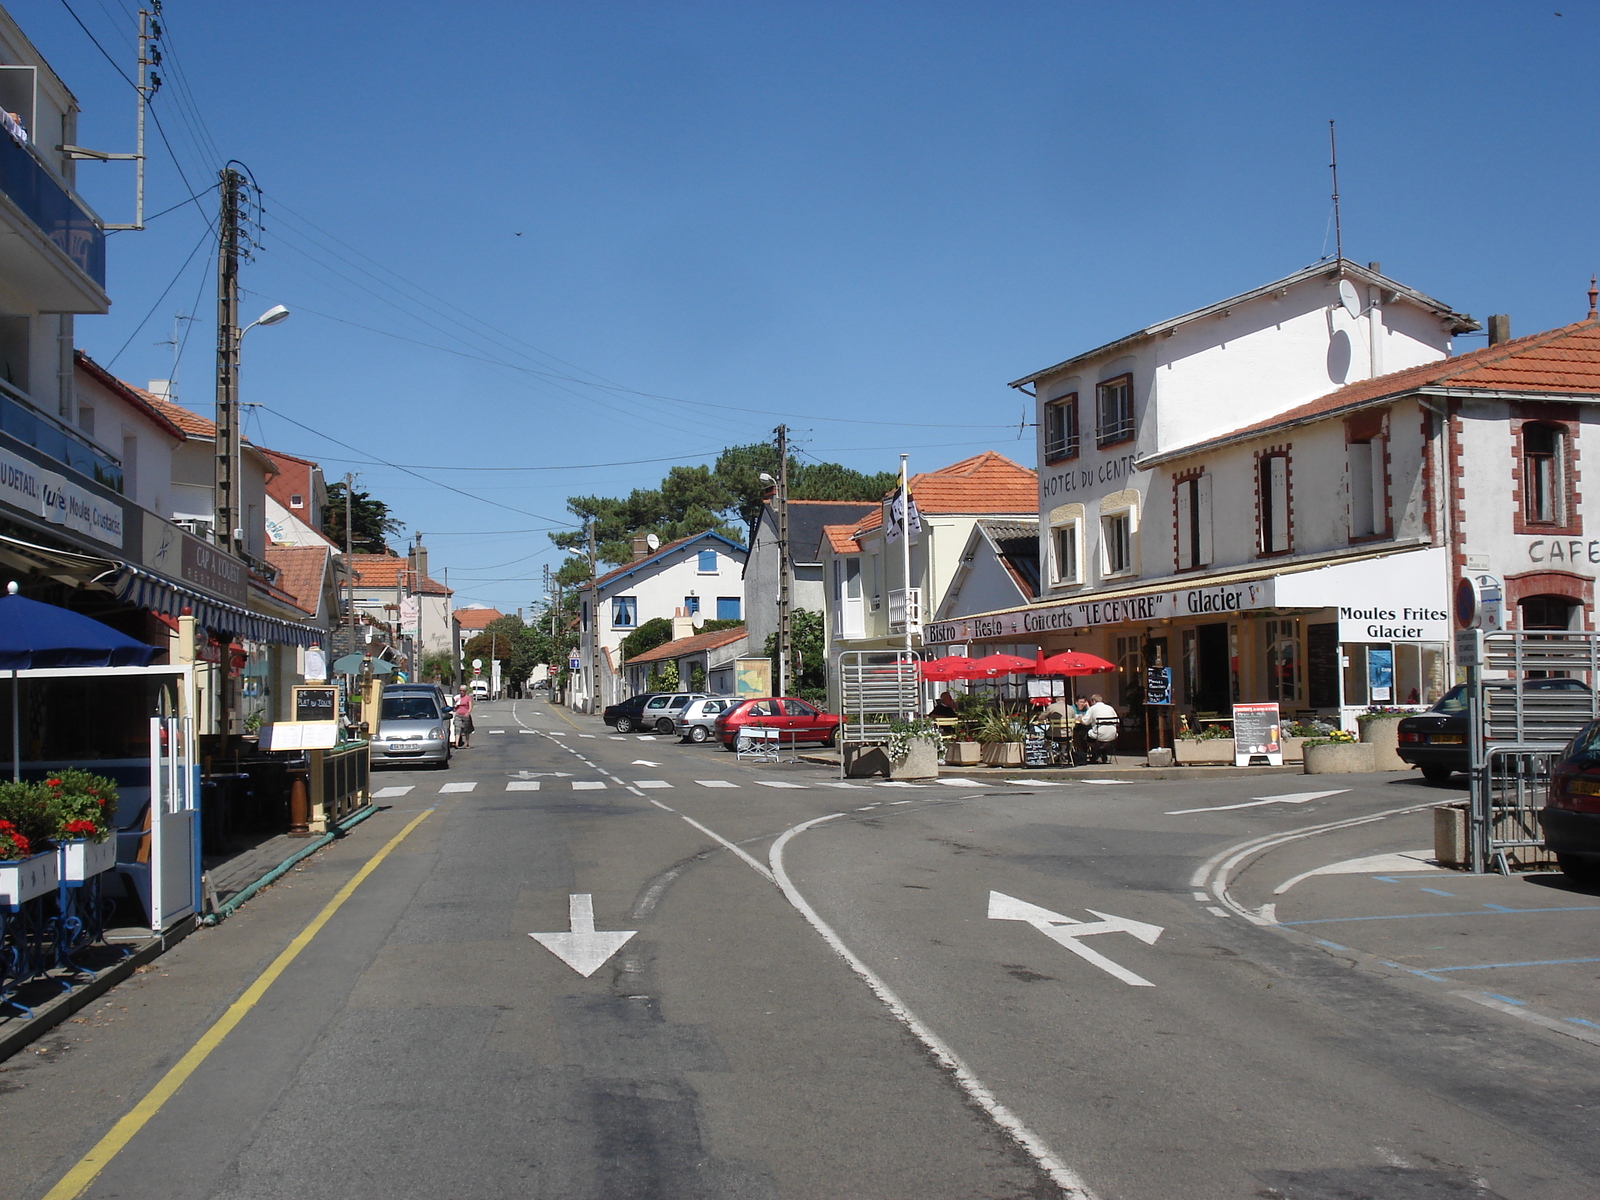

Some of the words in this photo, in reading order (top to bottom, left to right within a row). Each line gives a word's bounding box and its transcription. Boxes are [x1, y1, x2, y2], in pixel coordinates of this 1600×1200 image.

[1043, 471, 1076, 497] HOTEL
[1082, 470, 1094, 488] DU
[196, 546, 210, 570] CAP
[930, 625, 956, 642] Bistro
[974, 618, 1003, 637] Resto
[1024, 608, 1073, 632] Concerts
[1187, 587, 1242, 613] Glacier
[1340, 607, 1396, 620] Moules
[1403, 607, 1448, 620] Frites
[1367, 625, 1423, 638] Glacier
